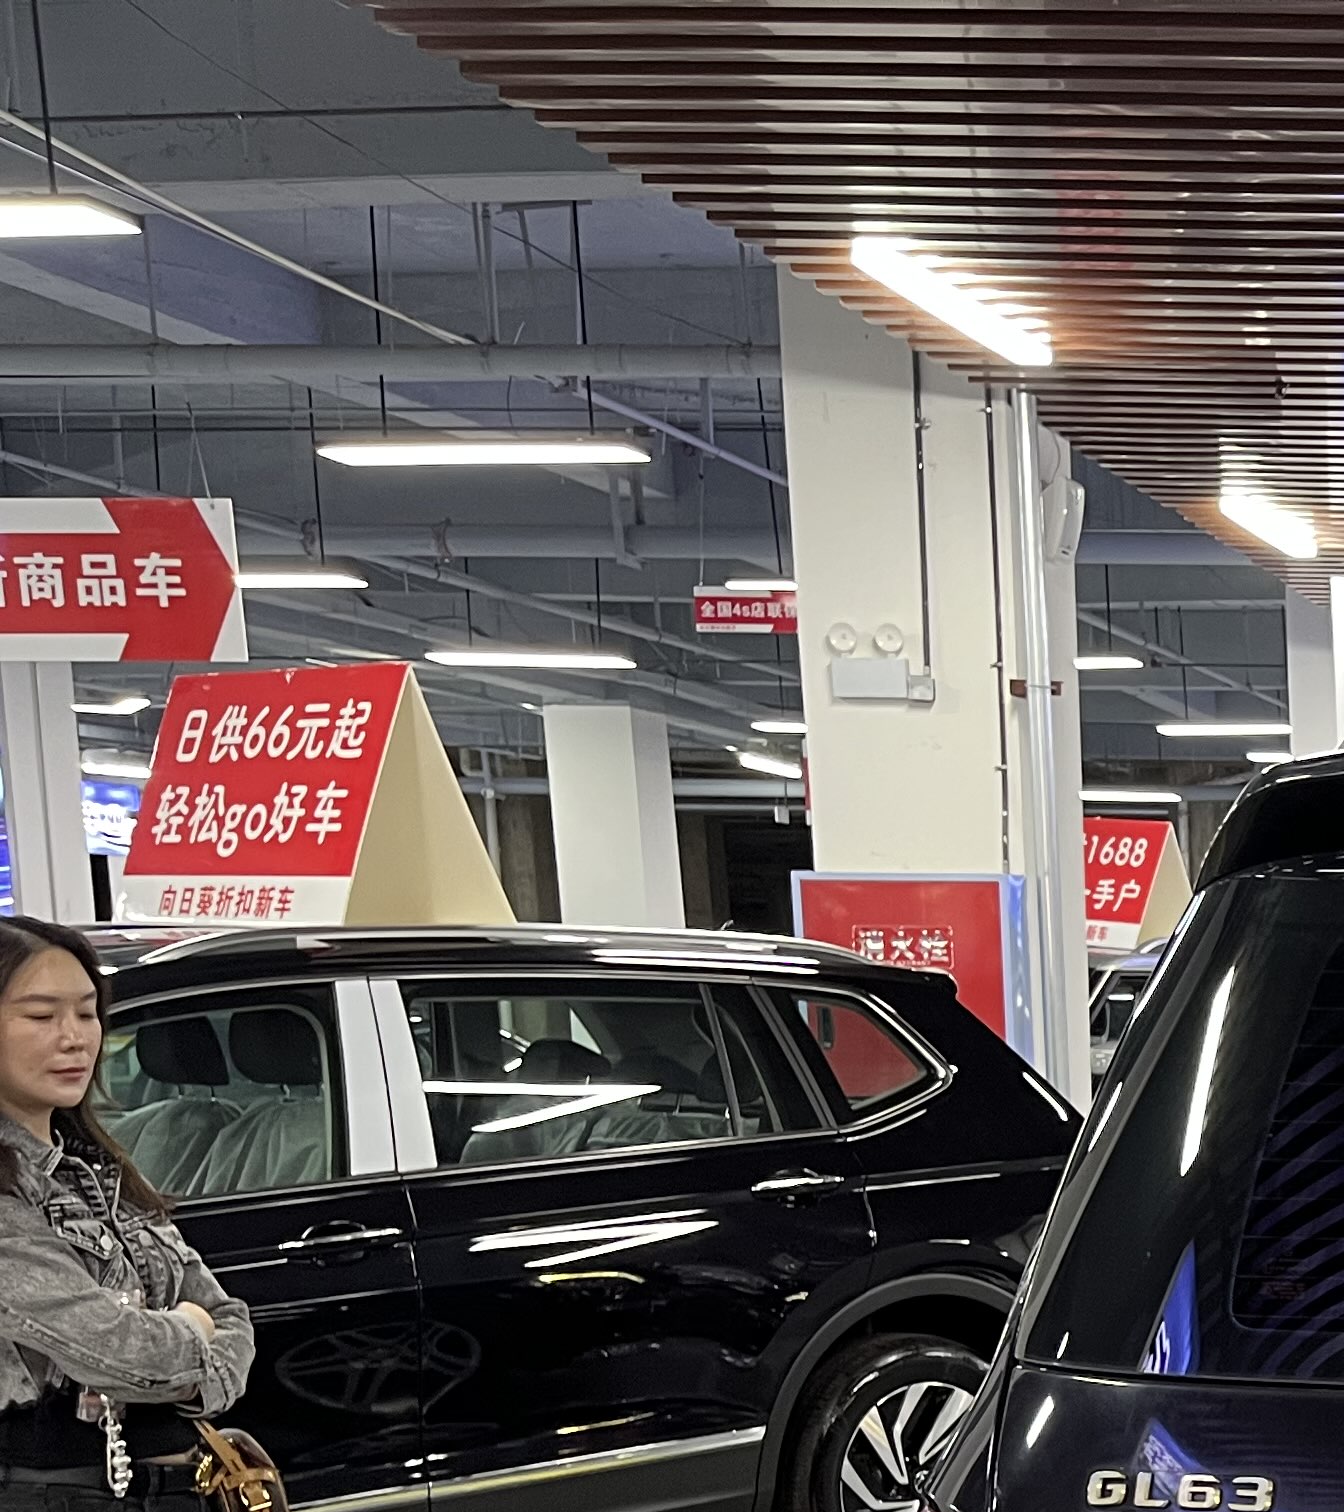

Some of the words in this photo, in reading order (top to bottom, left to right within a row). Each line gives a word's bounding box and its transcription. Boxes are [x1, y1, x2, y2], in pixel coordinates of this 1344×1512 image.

[0, 552, 187, 608] 商品车
[176, 698, 372, 763] 日供66元起
[151, 780, 349, 858] 轻松go好车
[158, 885, 295, 919] 向日葵折扣新车
[1087, 1470, 1274, 1512] GL63
